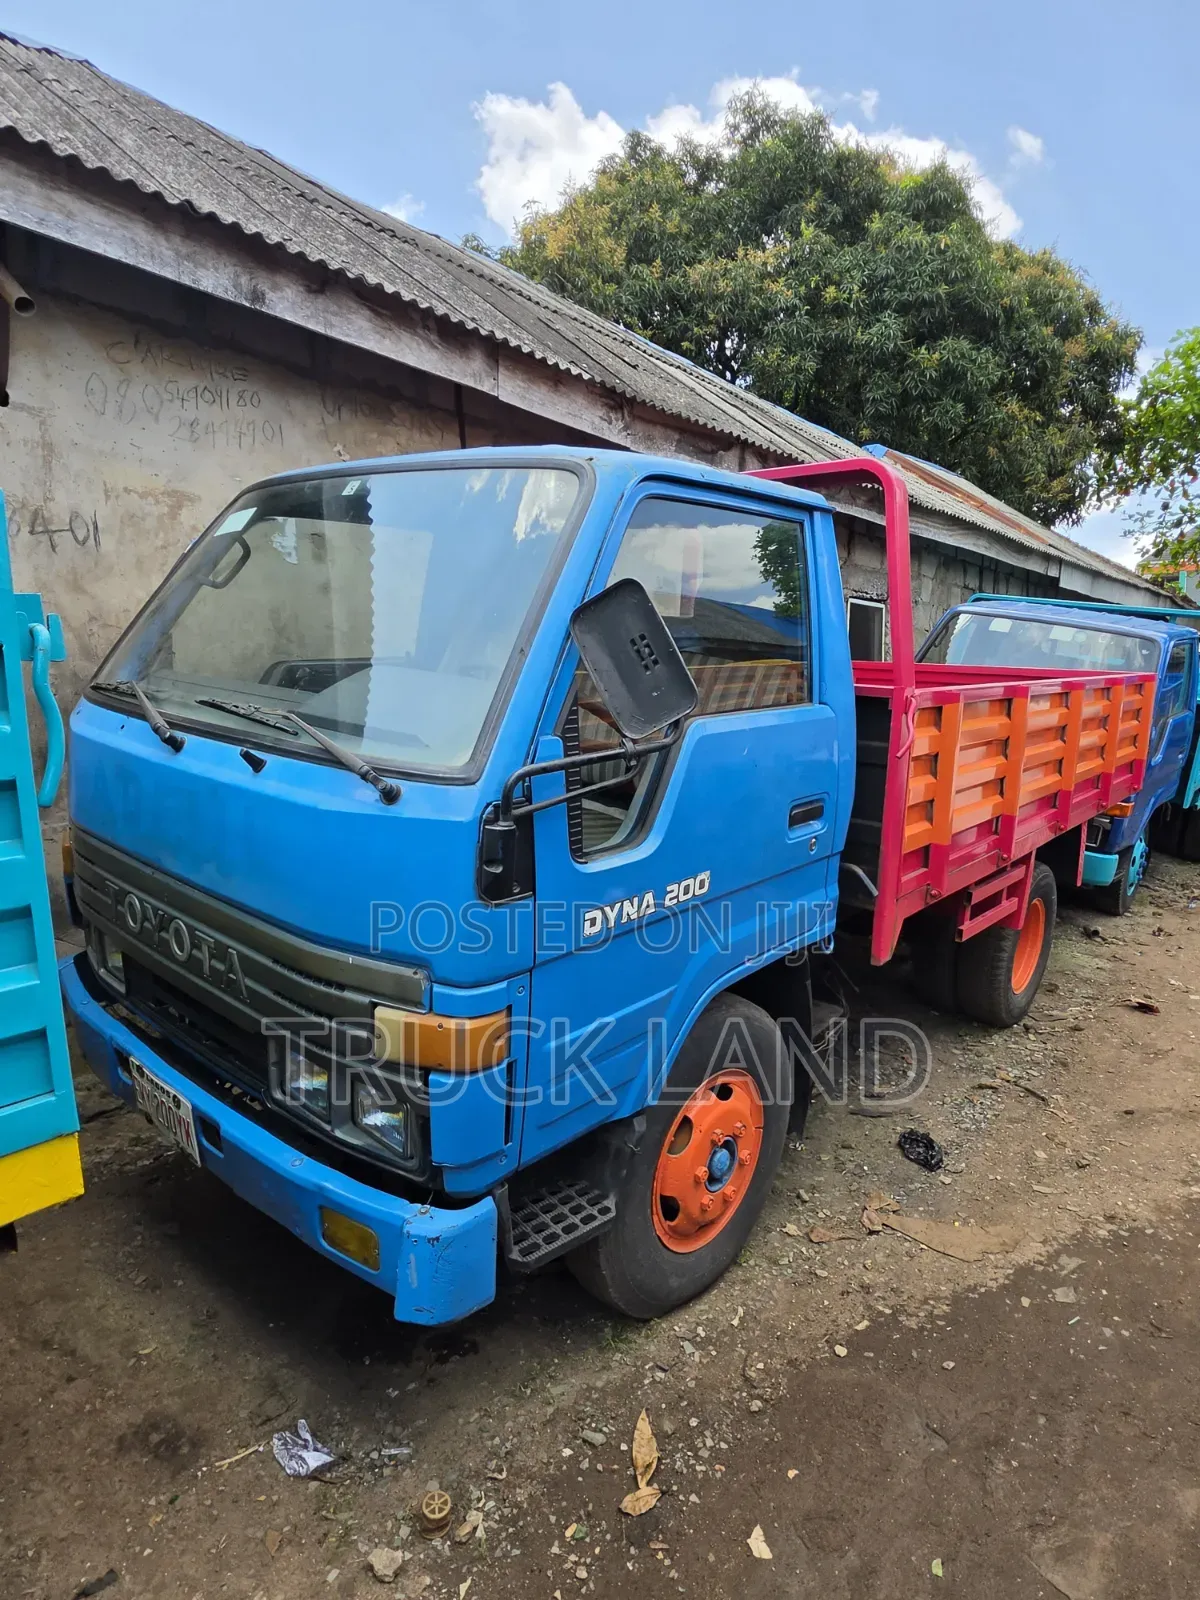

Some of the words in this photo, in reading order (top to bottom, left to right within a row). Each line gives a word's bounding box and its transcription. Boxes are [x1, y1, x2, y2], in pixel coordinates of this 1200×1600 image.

[105, 880, 250, 1002] TOYOTA
[583, 889, 656, 937] DYNA
[663, 869, 711, 908] 200
